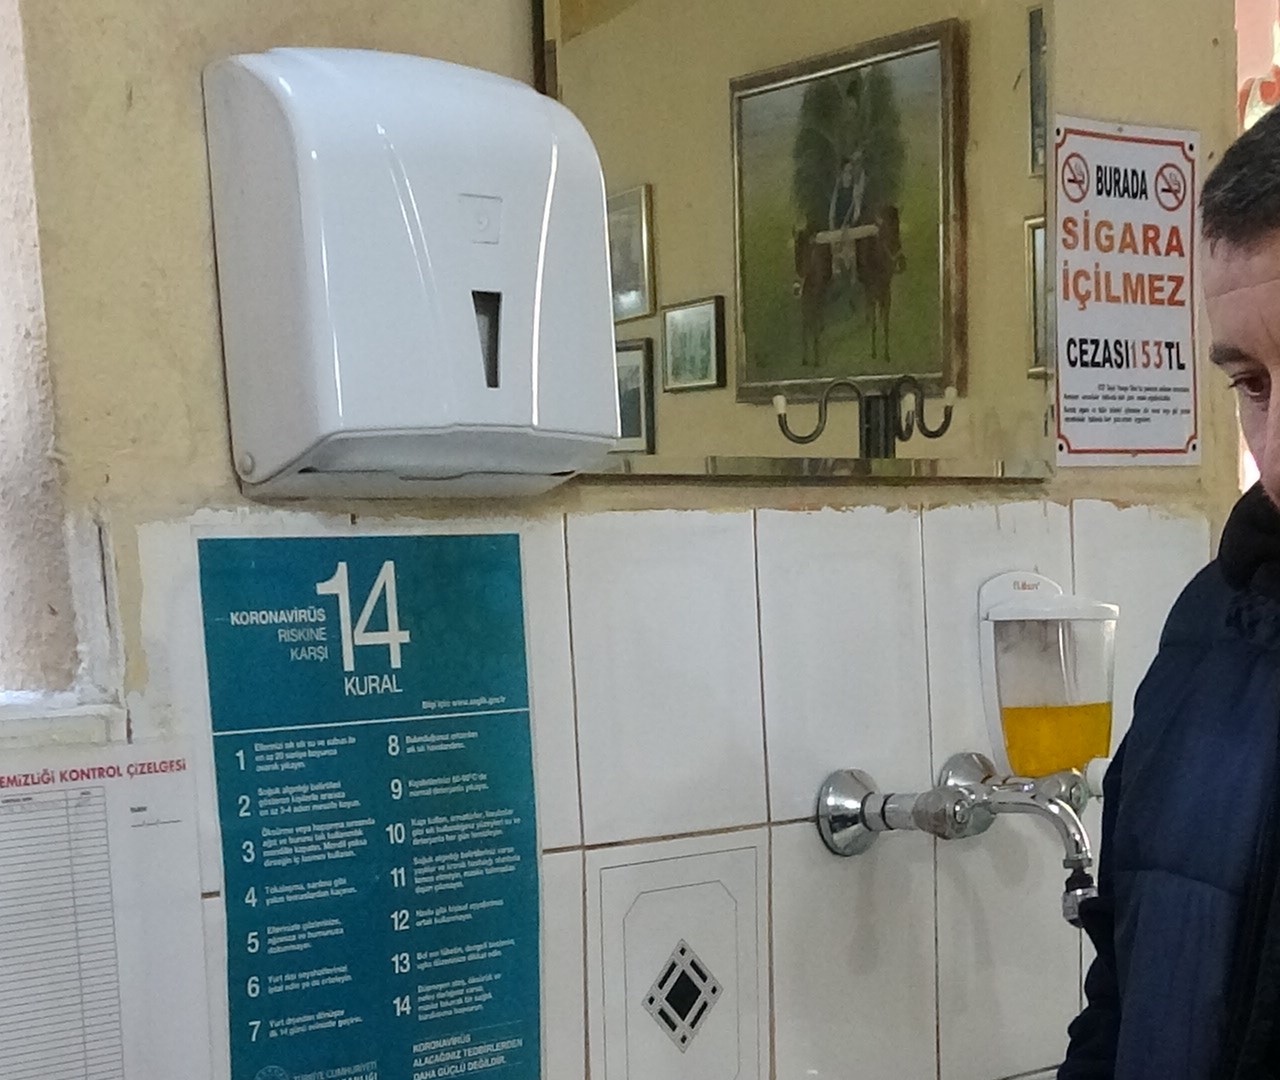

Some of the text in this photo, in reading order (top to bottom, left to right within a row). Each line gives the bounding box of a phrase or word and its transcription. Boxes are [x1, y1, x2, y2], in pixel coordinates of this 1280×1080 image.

[1096, 165, 1148, 200] BURADA
[1062, 209, 1185, 257] SİGARA
[1062, 259, 1186, 311] İÇİLMEZ
[1067, 338, 1186, 370] CEZASI 153 TL
[230, 606, 326, 626] KORONAVİRÜS
[316, 560, 411, 672] 14
[290, 645, 328, 662] KARŞI
[344, 674, 403, 696] KURAL
[388, 735, 400, 756] 8
[235, 749, 246, 770] 1
[60, 765, 122, 783] KONTROL
[391, 779, 403, 800] 9
[238, 795, 251, 817] 2
[385, 823, 405, 844] 10
[242, 841, 256, 863] 3
[390, 867, 406, 888] 11
[244, 887, 258, 907] 4
[390, 910, 410, 931] 12
[247, 932, 259, 953] 5
[391, 953, 411, 974] 13
[247, 977, 260, 998] 6
[393, 995, 412, 1017] 14
[248, 1021, 261, 1042] 7
